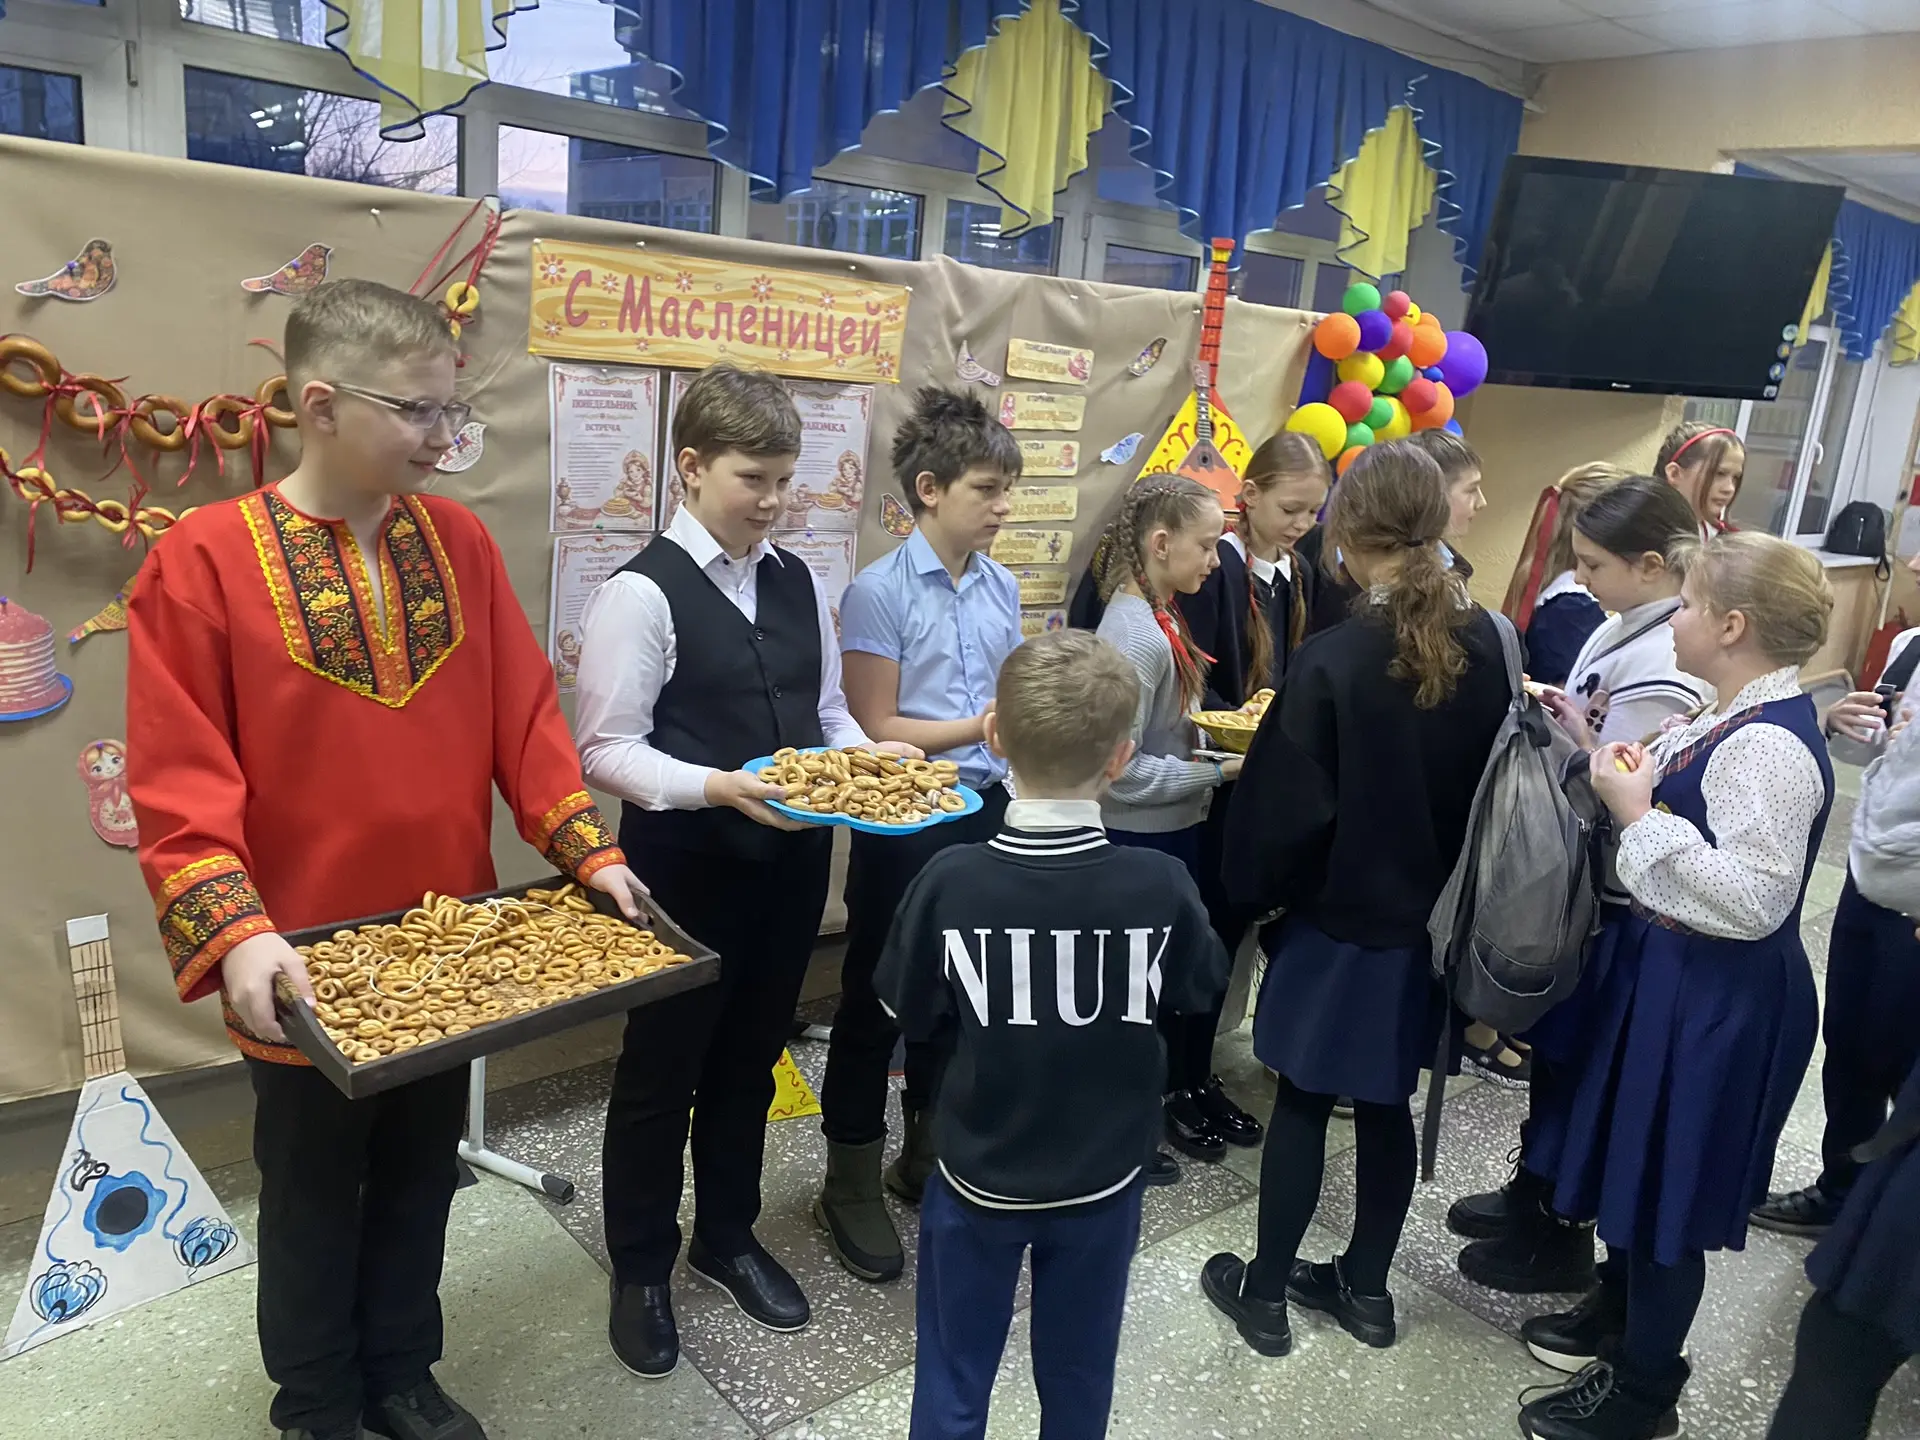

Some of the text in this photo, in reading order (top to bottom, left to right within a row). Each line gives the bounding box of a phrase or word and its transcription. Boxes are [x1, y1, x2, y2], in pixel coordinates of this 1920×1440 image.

[564, 269, 881, 359] С Масленицей
[572, 399, 638, 411] ПОНЕДЕЛЬНИК
[585, 423, 621, 432] ВСТРЕЧА
[803, 421, 847, 433] АКОМКА
[942, 925, 1172, 1027] NIUK
